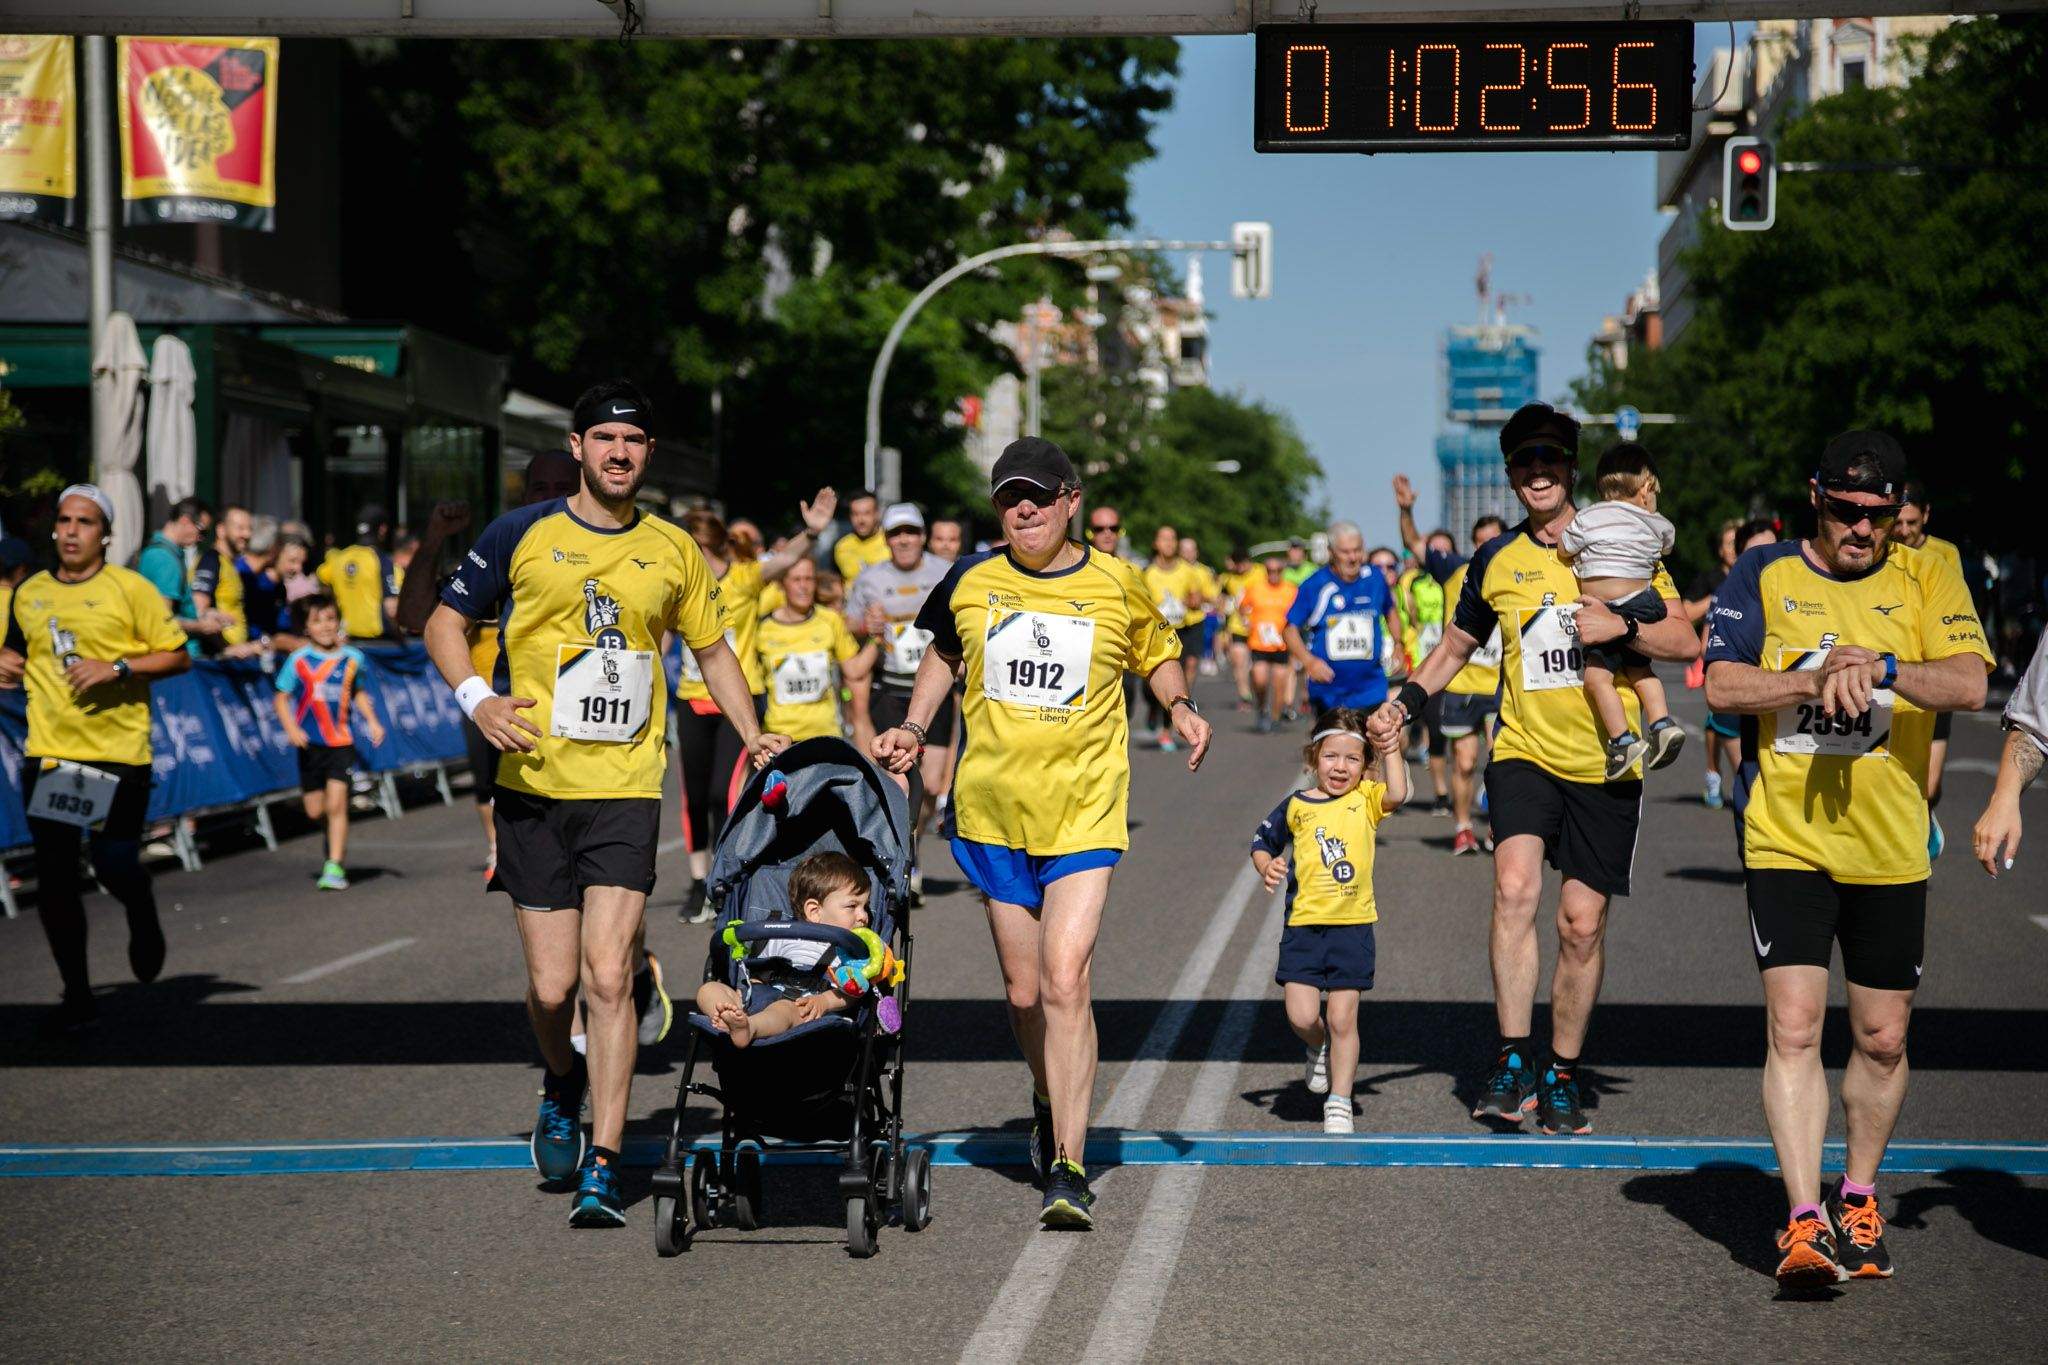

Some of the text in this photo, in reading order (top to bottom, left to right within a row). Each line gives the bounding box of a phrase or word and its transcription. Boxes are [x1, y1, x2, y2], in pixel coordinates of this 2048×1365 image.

[602, 635, 621, 650] 13
[1539, 648, 1581, 674] 190
[1006, 659, 1065, 690] 1912
[579, 696, 631, 724] 1911
[1040, 705, 1071, 714] Carrera
[1040, 714, 1070, 724] Liberty
[1797, 704, 1872, 737] 2594
[48, 792, 94, 817] 1839
[1336, 865, 1351, 878] 13
